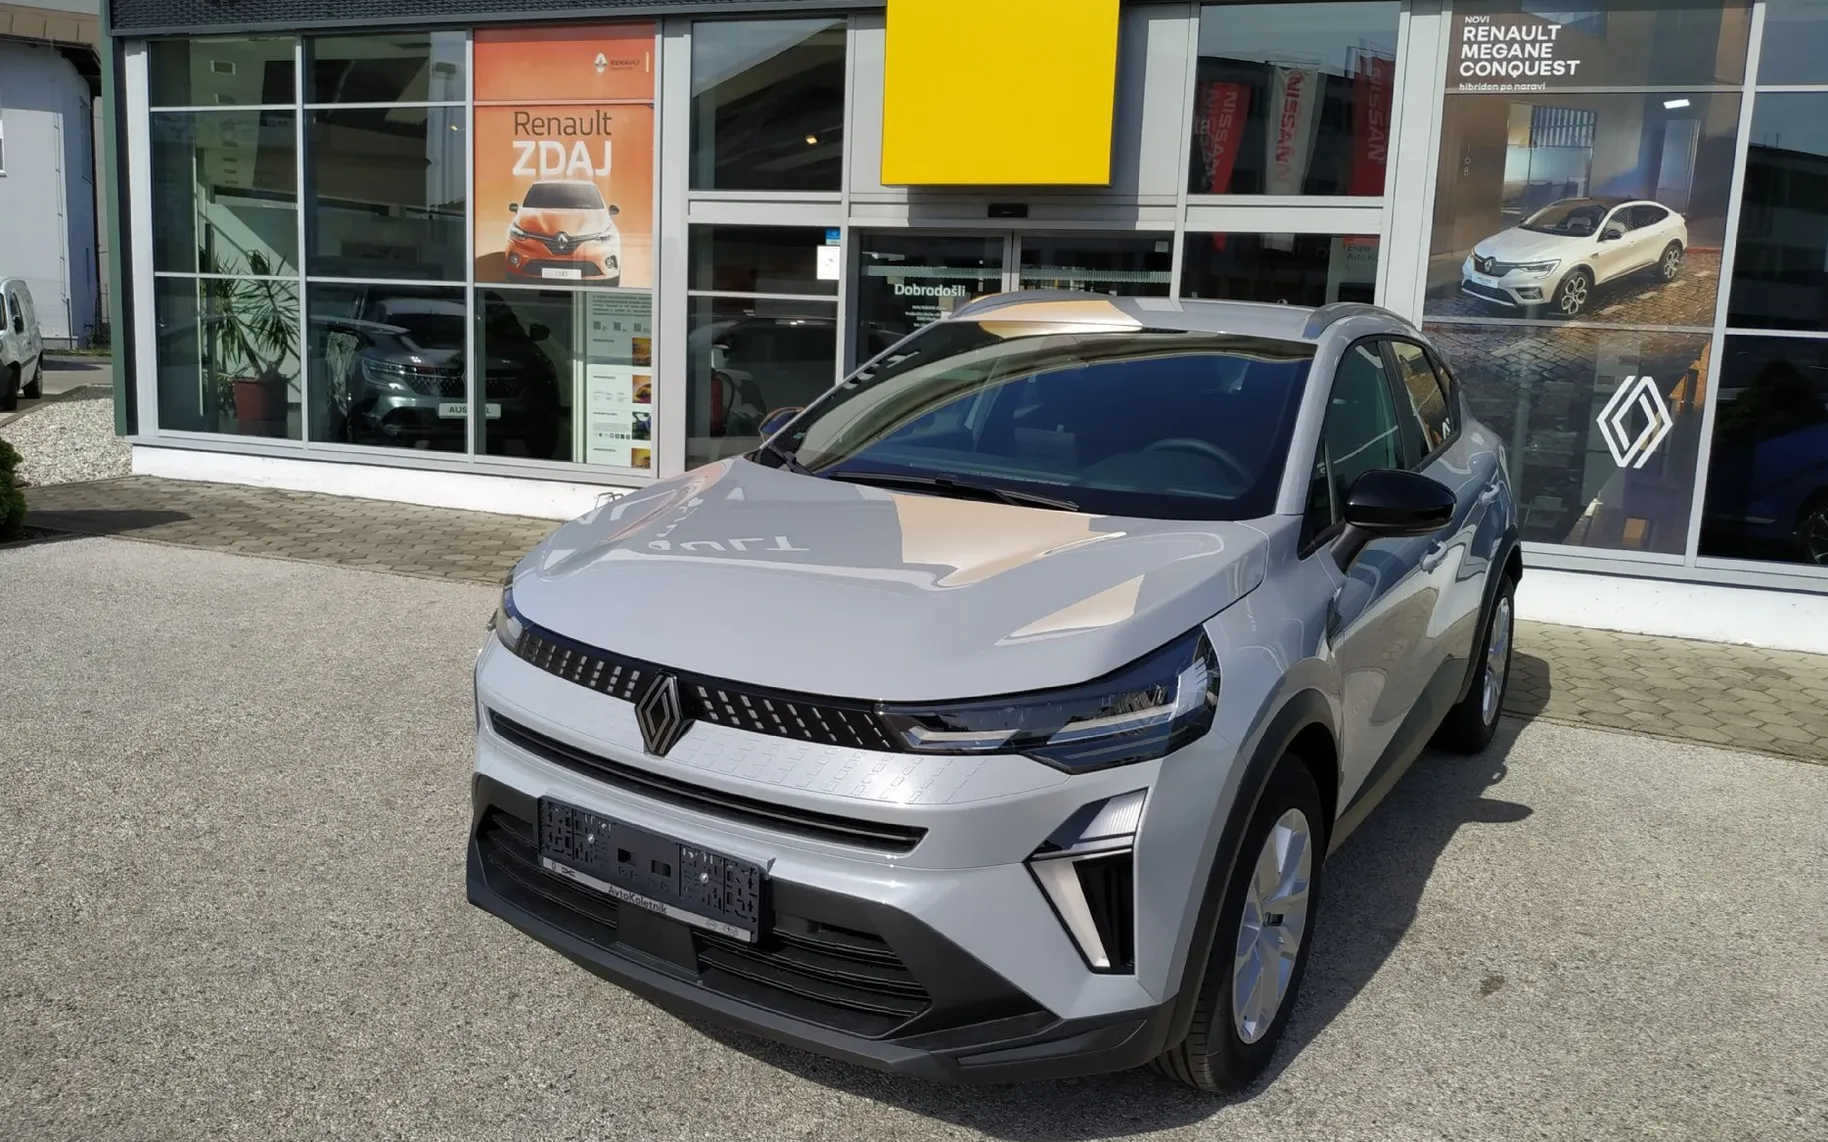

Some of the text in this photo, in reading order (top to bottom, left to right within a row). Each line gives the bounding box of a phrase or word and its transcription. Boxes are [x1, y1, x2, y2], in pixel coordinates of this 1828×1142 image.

[1464, 15, 1490, 24] NOVI
[1463, 24, 1562, 41] RENAULT
[1461, 42, 1554, 59] MEGANE
[1459, 60, 1581, 78] CONQUEST
[1459, 82, 1547, 92] hibriden po naravi
[513, 109, 613, 136] Renault
[512, 140, 612, 177] ZDAJ
[893, 283, 967, 297] Dobrodošli
[607, 885, 669, 915] AvtoKoletnik
